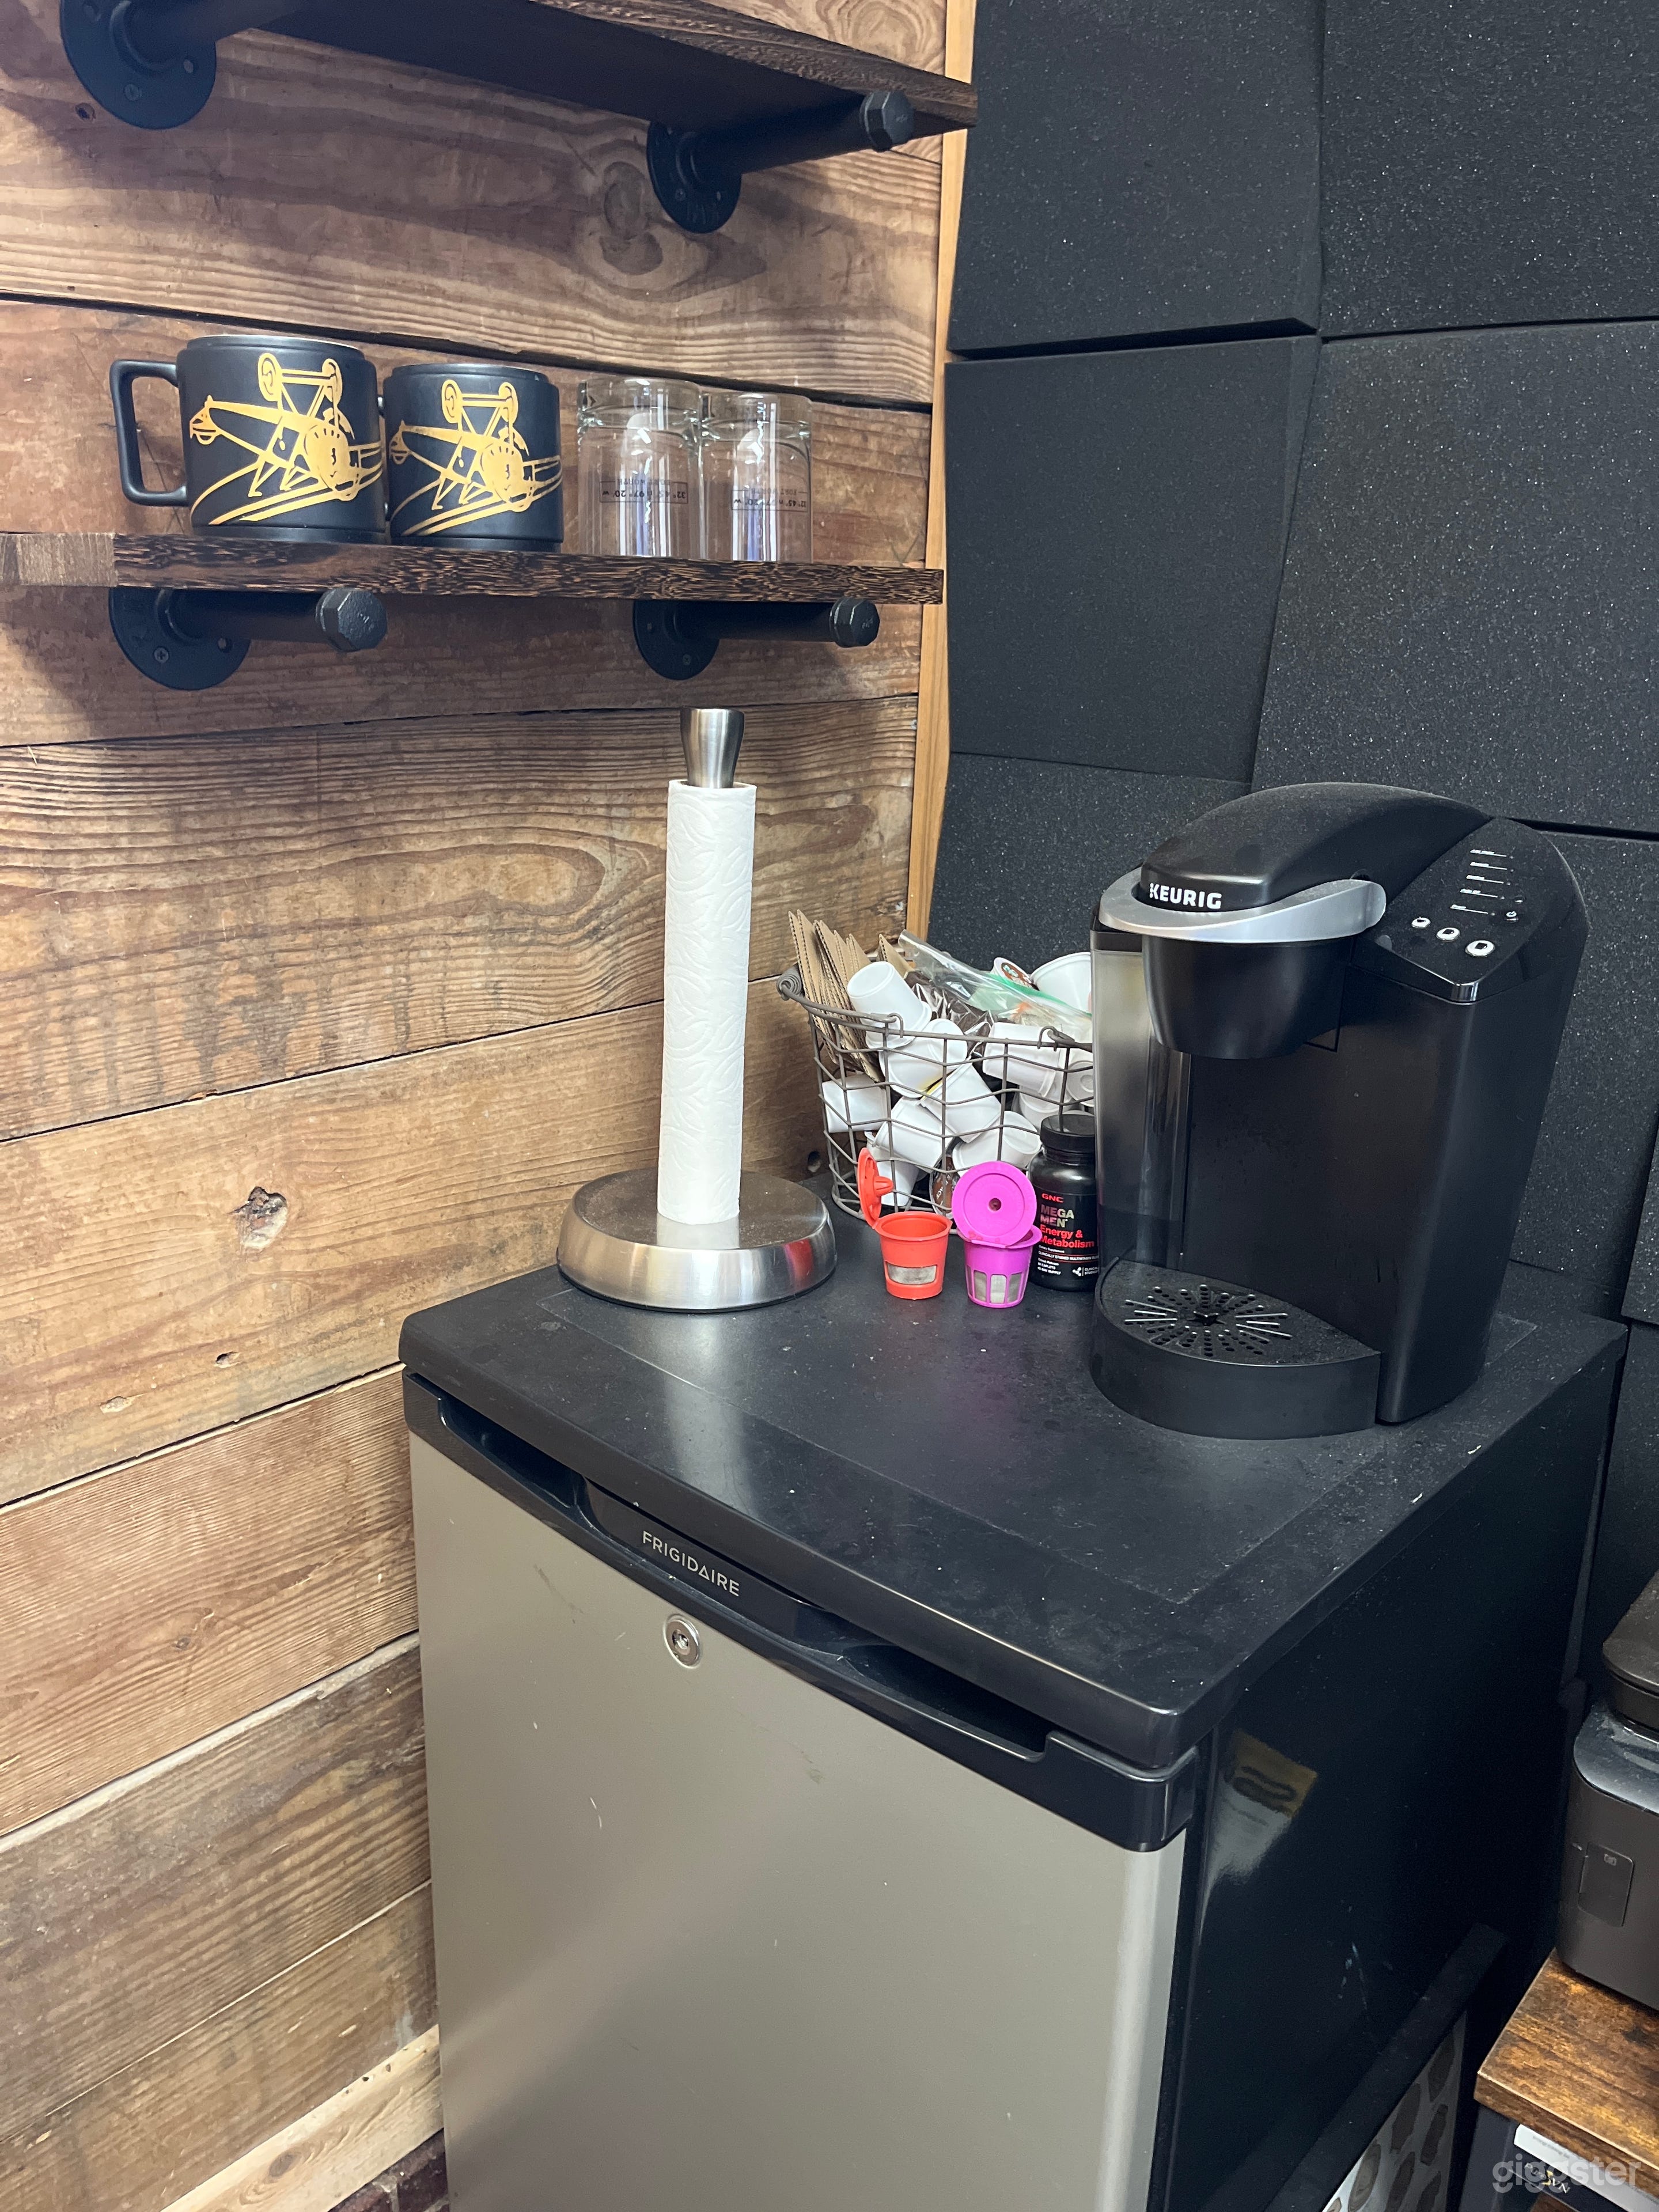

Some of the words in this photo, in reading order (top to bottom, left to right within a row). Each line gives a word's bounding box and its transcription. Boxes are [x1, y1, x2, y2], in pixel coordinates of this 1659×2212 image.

[1149, 882, 1222, 910] KEURIG
[1041, 1193, 1064, 1203] GNC
[1041, 1204, 1075, 1219] MEGA
[1040, 1224, 1074, 1239] Energy
[1075, 1229, 1083, 1238] &
[1041, 1236, 1094, 1248] Metabolism
[642, 1531, 740, 1597] FRIGIDAIRE
